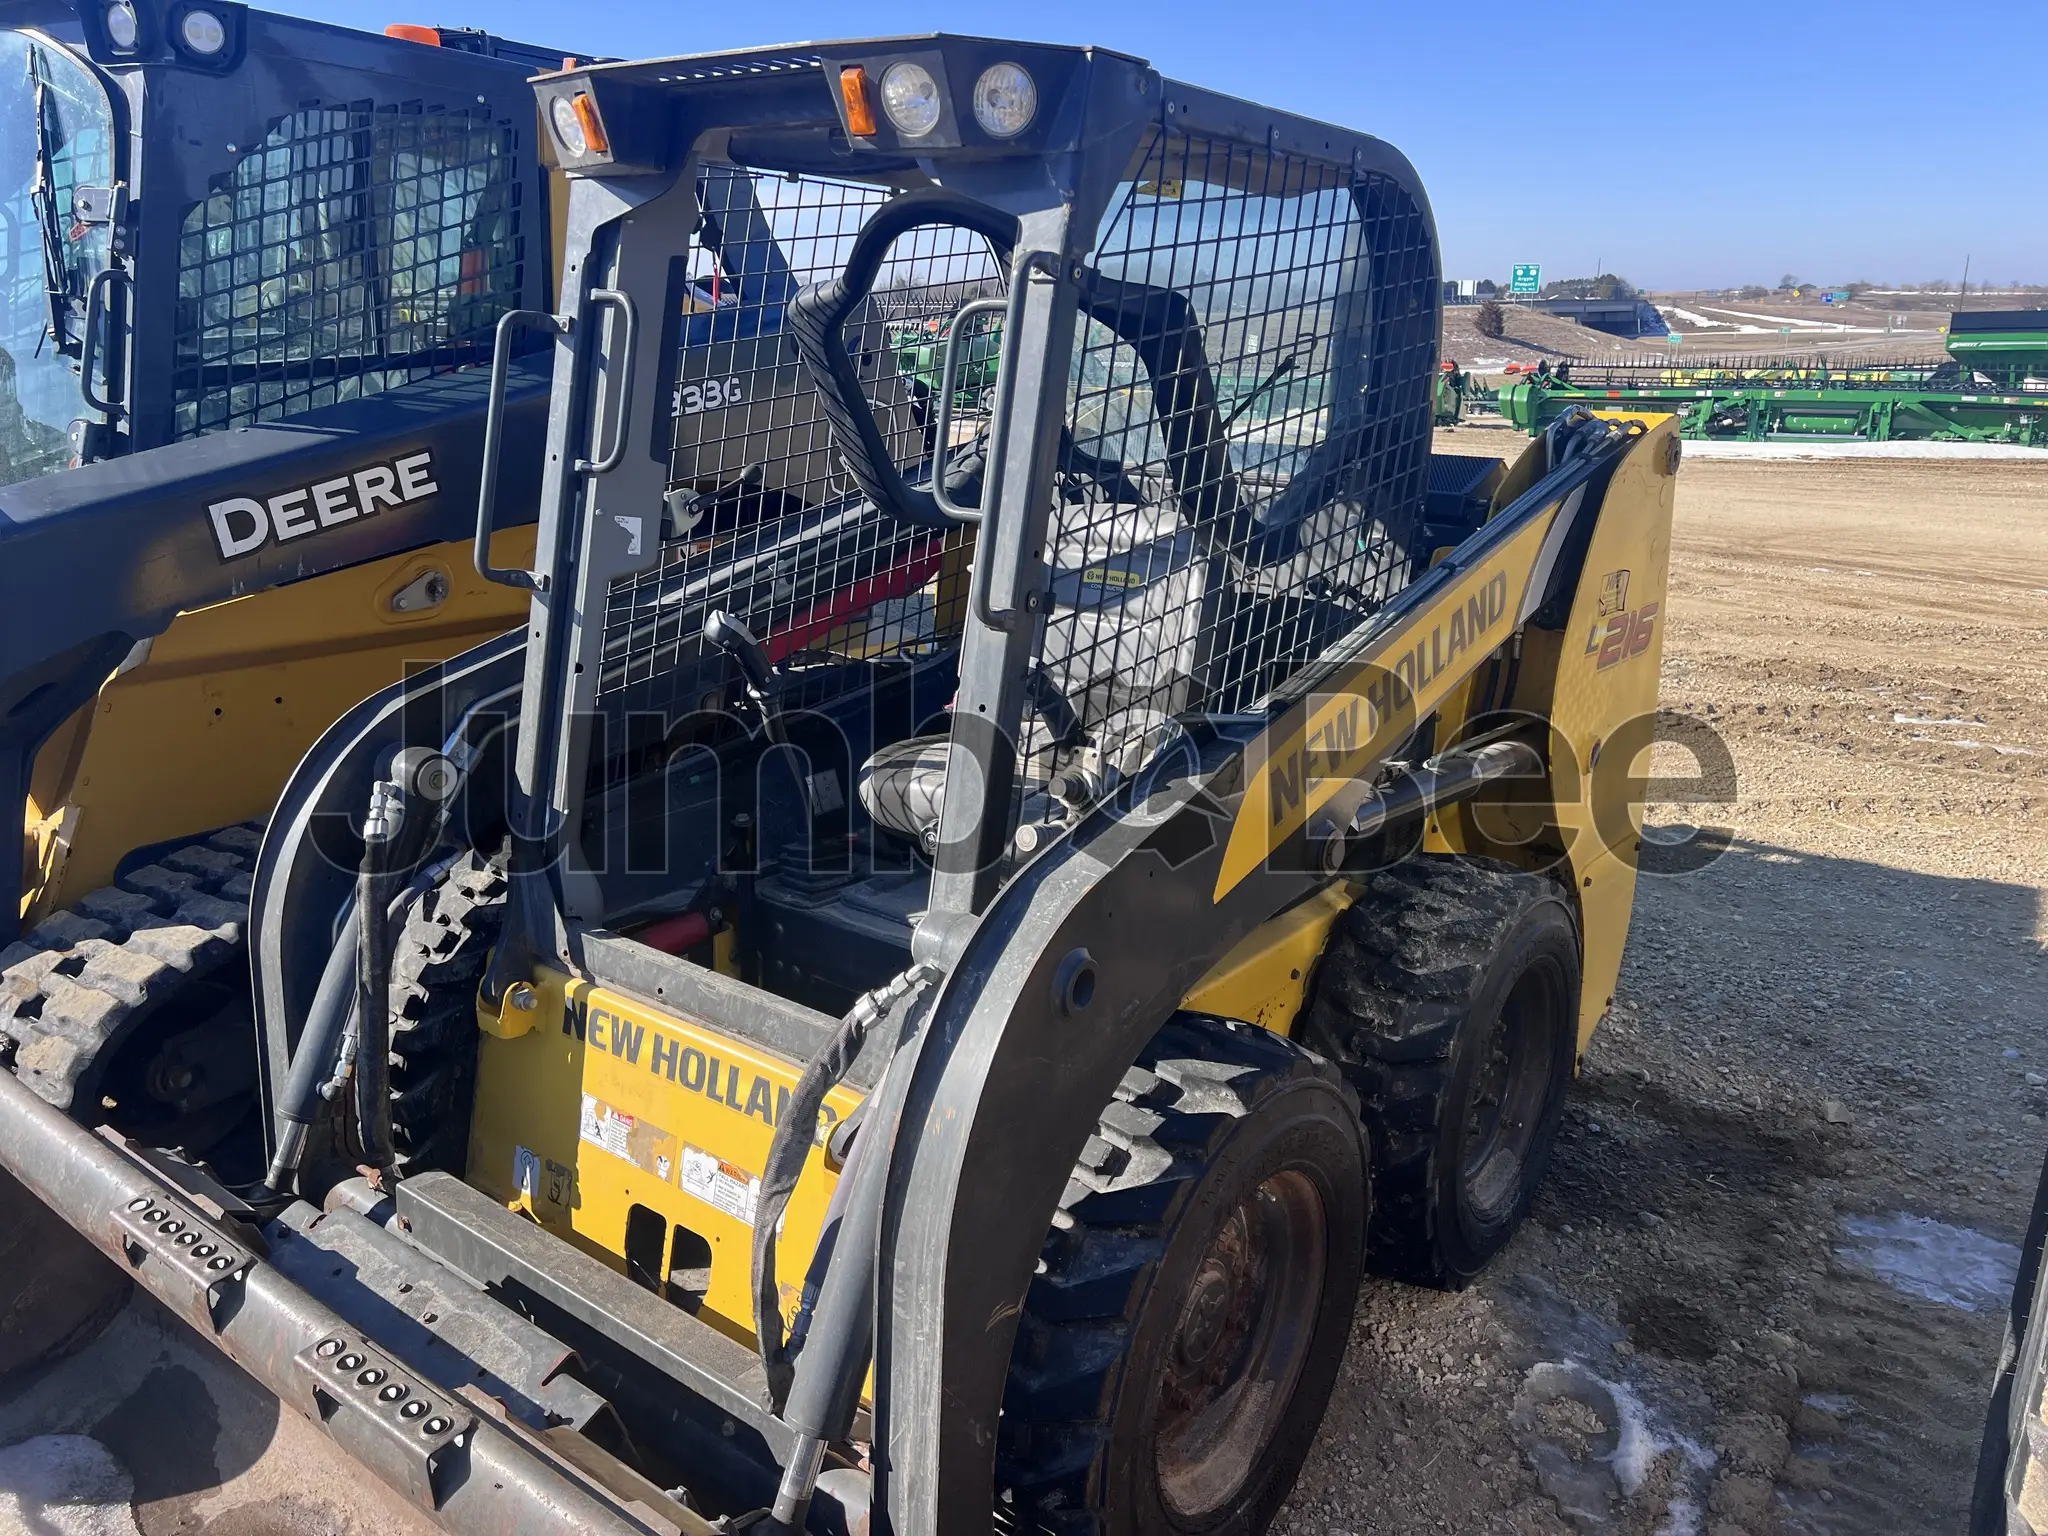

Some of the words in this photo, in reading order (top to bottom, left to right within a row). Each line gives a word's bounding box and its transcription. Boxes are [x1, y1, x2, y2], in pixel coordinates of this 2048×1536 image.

[208, 452, 438, 559] DEERE
[1584, 602, 1659, 674] L216
[1270, 696, 1359, 828] NEW
[1367, 569, 1507, 739] HOLLAND
[562, 995, 645, 1065] NEW
